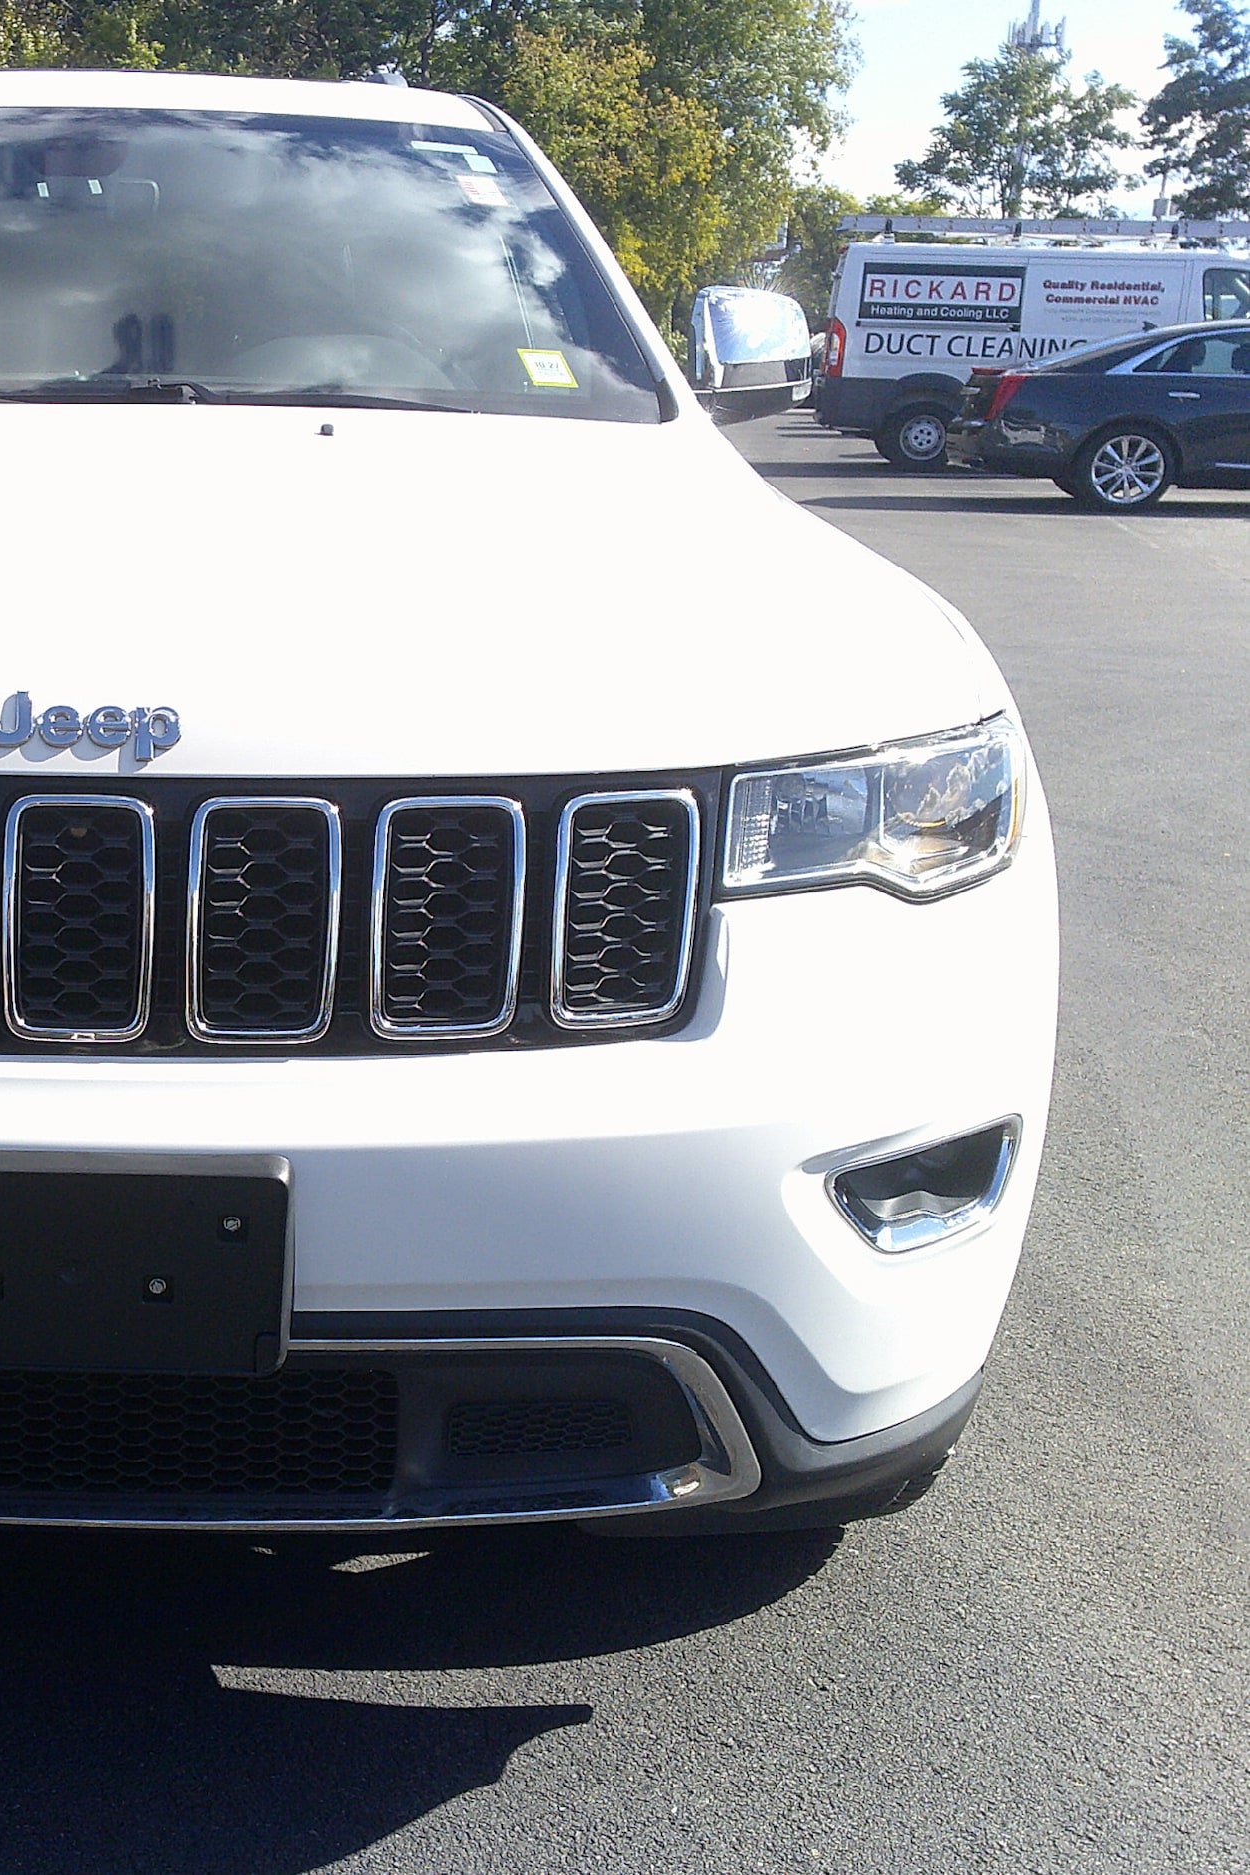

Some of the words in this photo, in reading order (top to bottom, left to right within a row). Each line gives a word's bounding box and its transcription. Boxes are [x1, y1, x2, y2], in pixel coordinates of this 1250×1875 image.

[869, 278, 1016, 302] RICKARD
[1043, 280, 1087, 291] Quality
[1090, 280, 1165, 293] Residential,
[1046, 293, 1119, 305] Commercial
[1123, 296, 1159, 305] HVAC
[871, 305, 913, 316] Heating
[916, 308, 938, 317] and
[940, 307, 983, 319] Cooling
[985, 308, 1010, 319] LLC
[864, 332, 941, 355] DUCT
